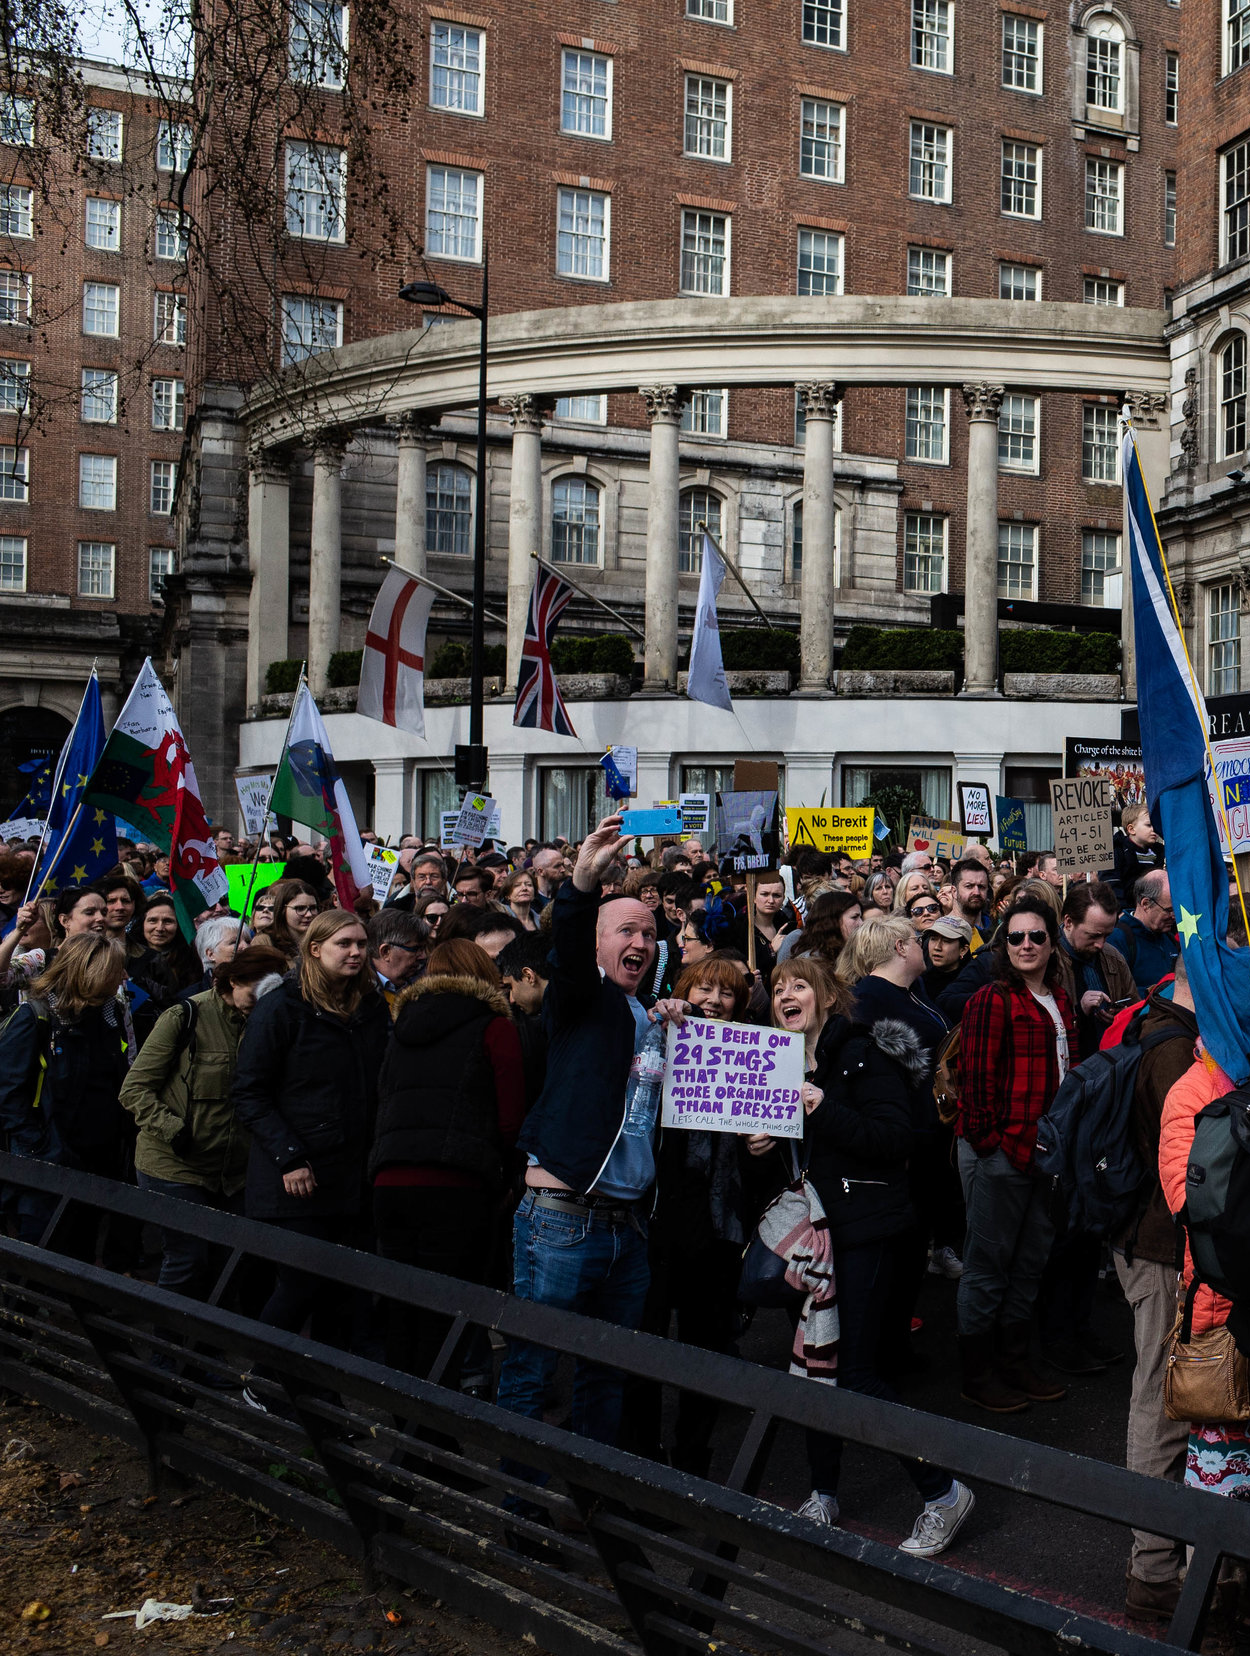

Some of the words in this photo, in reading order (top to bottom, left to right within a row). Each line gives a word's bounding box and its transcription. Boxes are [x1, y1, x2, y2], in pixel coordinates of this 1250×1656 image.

[1074, 743, 1100, 757] Charge
[1101, 745, 1109, 755] of
[1109, 745, 1121, 755] the
[250, 791, 266, 807] We
[968, 789, 981, 800] NO
[1053, 780, 1110, 812] REVOKE
[965, 801, 987, 810] MORE
[812, 815, 827, 827] No
[832, 815, 867, 827] Brexit
[912, 816, 940, 830] AND
[966, 812, 988, 825] LIES!
[1058, 810, 1109, 826] ARTICLES
[846, 834, 868, 843] people
[911, 829, 936, 841] WILL
[1059, 825, 1102, 844] 49-51
[838, 843, 867, 851] alarmed
[1004, 836, 1026, 850] FUTURE
[1059, 847, 1072, 856] TO
[1077, 844, 1089, 854] BE
[1094, 843, 1106, 851] ON
[935, 842, 963, 860] EU
[747, 853, 769, 869] BREXIT
[1058, 857, 1076, 867] THE
[1079, 854, 1096, 864] SAFE
[1099, 852, 1114, 861] SIDE
[676, 1021, 715, 1040] I'VE
[722, 1027, 761, 1045] BEEN
[768, 1034, 791, 1048] ON
[673, 1043, 703, 1065] 29
[706, 1046, 776, 1072] STAGS
[672, 1068, 718, 1084] THAT
[725, 1072, 767, 1086] WERE
[670, 1085, 711, 1099] MORE
[714, 1086, 800, 1105] ORGANISED
[674, 1100, 723, 1114] THAN
[730, 1100, 797, 1120] BREXIT
[672, 1113, 692, 1125] LETS
[695, 1115, 715, 1125] CALL
[718, 1117, 732, 1126] THE
[735, 1120, 759, 1129] WHOLE
[761, 1122, 782, 1131] THING
